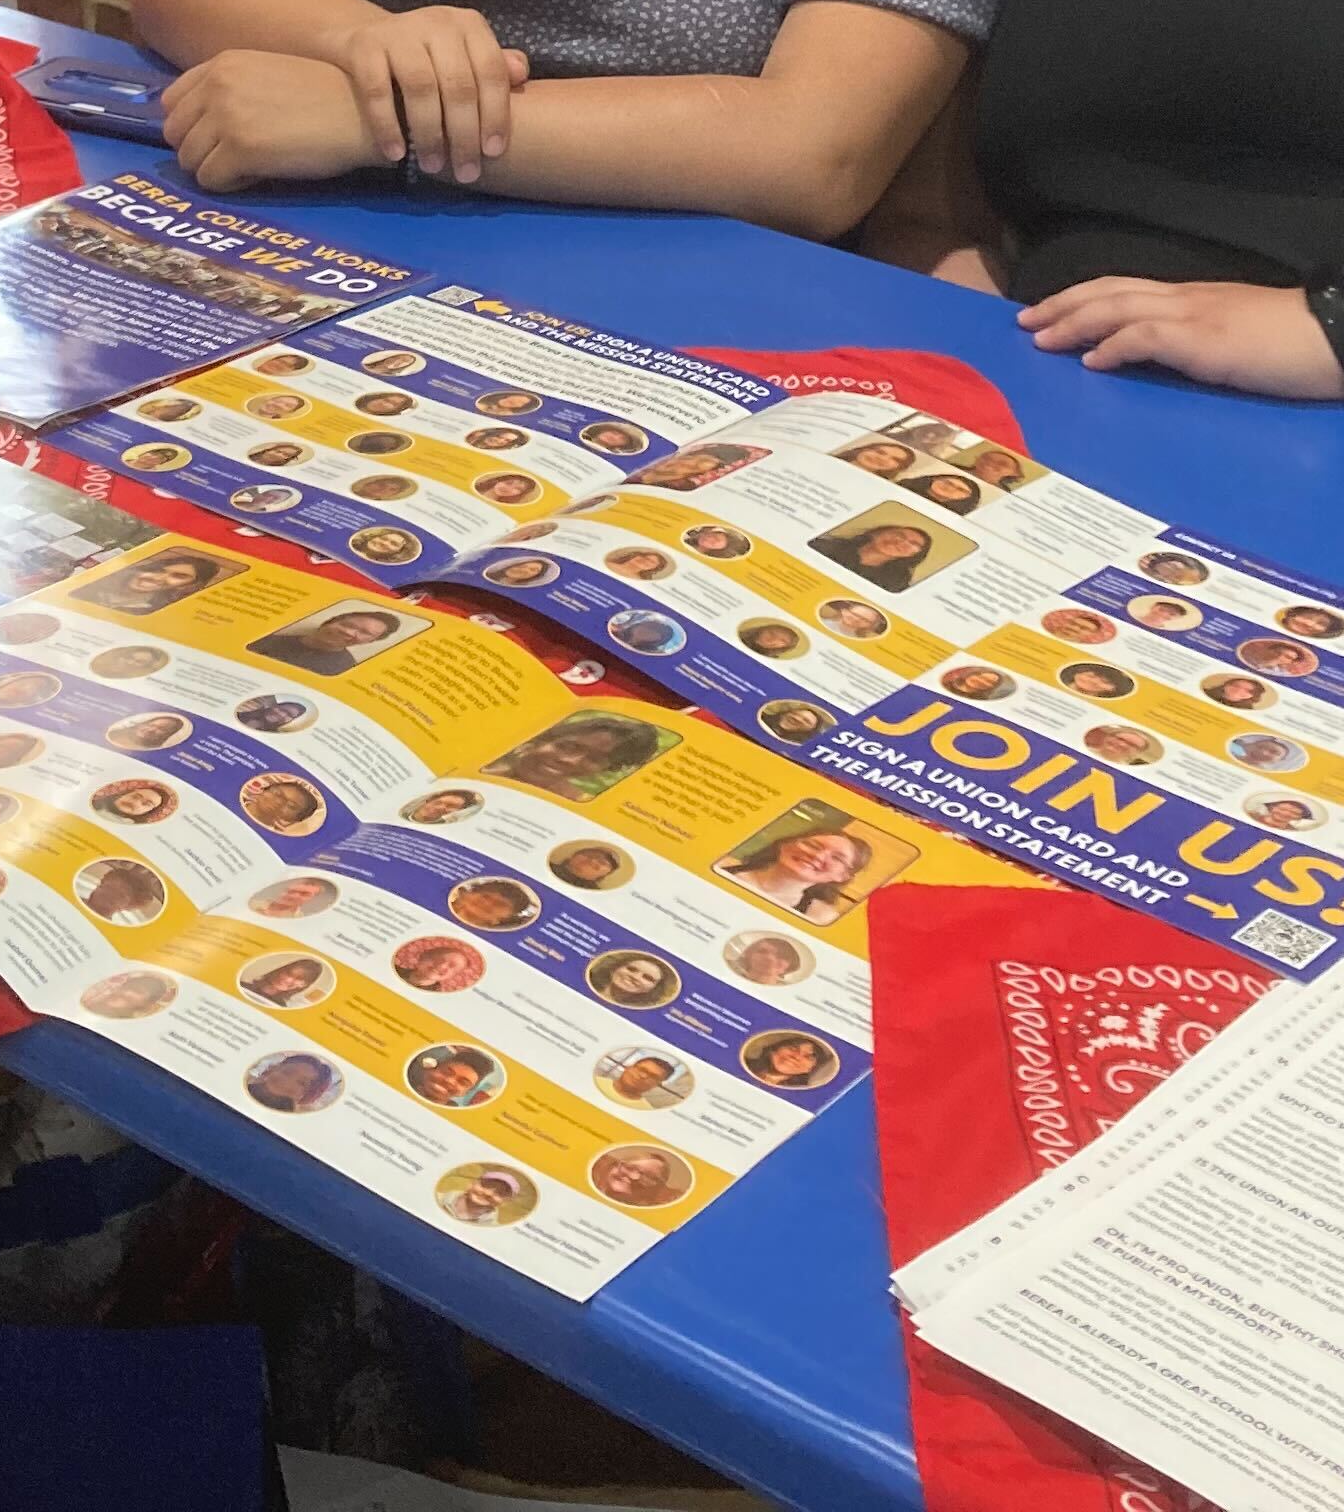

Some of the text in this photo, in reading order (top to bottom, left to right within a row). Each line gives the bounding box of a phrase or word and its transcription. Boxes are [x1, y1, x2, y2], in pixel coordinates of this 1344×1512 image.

[78, 184, 377, 294] BECAUSE WE DO
[114, 173, 410, 281] BEREA COLLEGE WORKS
[495, 312, 760, 406] AND THE MISSION STATEMENT
[523, 310, 561, 328] JOIN
[591, 332, 640, 352] SIGN
[636, 346, 651, 356] A
[652, 350, 715, 376] UNION
[717, 370, 770, 397] CARD
[832, 732, 1190, 889] SIGN A UNION CARD AND
[862, 701, 1167, 836] JOIN
[810, 745, 1172, 908] THE MISSION STATEMENT
[1274, 1091, 1312, 1112] WHY
[1311, 1109, 1340, 1126] DO
[1191, 1156, 1211, 1168] IS
[1206, 1164, 1239, 1183] THE
[1236, 1178, 1287, 1207] UNION
[1287, 1204, 1315, 1221] AN
[1090, 1234, 1285, 1343] BE PUBLIC IN MY SUPPORT?
[1102, 1225, 1134, 1244] OK,
[1130, 1239, 1161, 1259] I'M
[1154, 1253, 1251, 1307] PRO-UNION,
[1246, 1301, 1282, 1323] BUT
[1276, 1317, 1322, 1345] WHY
[1016, 1286, 1070, 1319] BEREA
[1062, 1312, 1084, 1327] IS
[1075, 1319, 1150, 1364] ALREADY
[1156, 1365, 1213, 1400] GREAT
[1205, 1393, 1279, 1438] SCHOOL
[1272, 1430, 1324, 1464] WITH
